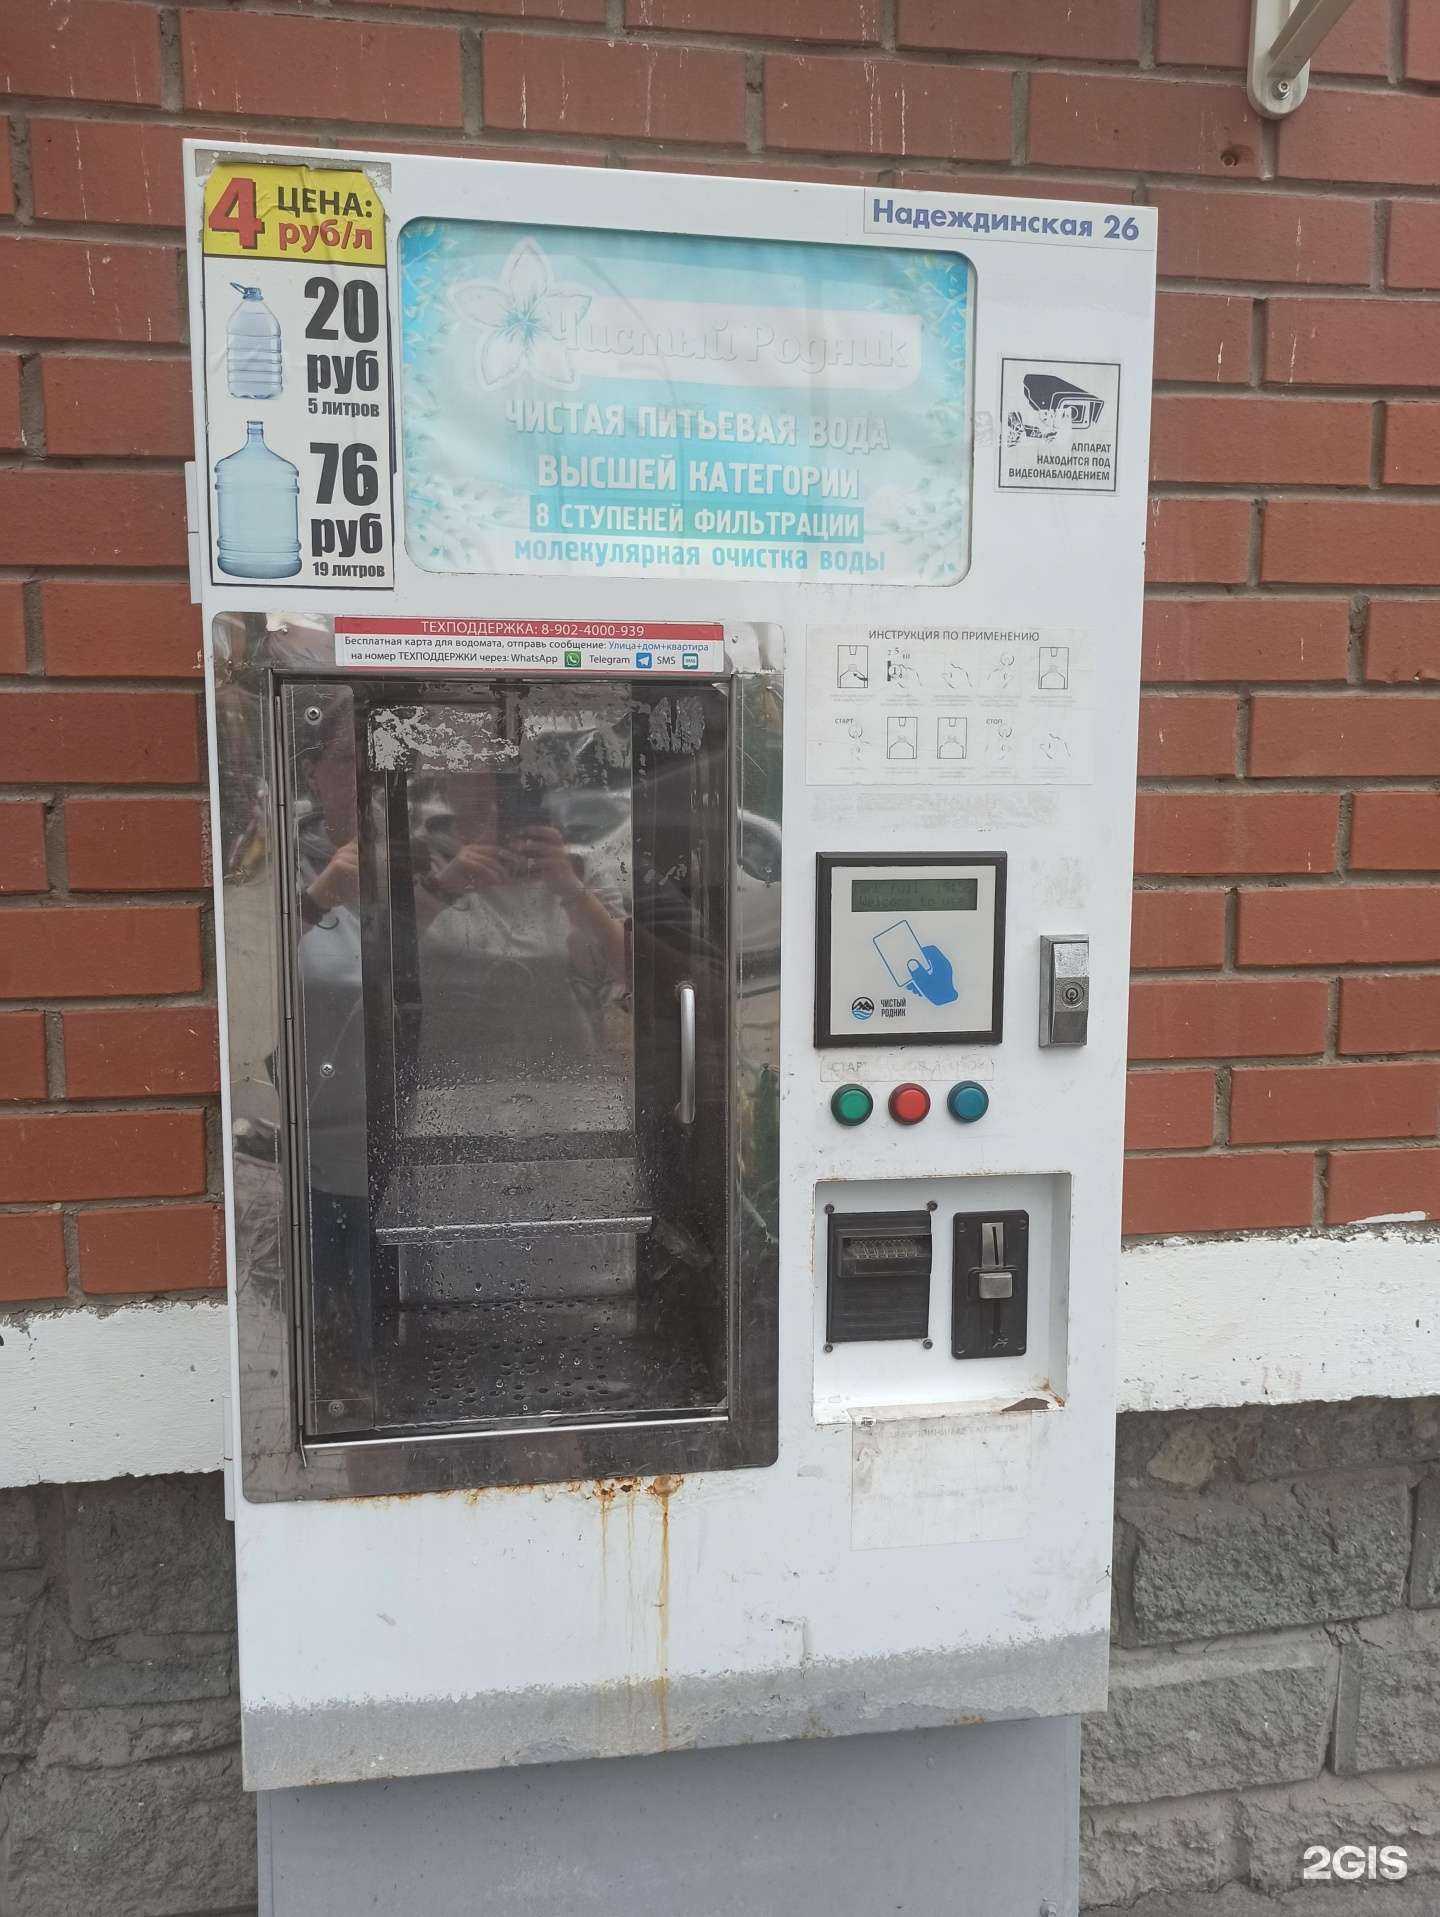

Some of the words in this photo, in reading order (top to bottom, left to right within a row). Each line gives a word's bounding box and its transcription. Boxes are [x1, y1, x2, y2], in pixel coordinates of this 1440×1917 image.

[208, 177, 265, 250] 4
[277, 186, 373, 218] ЦЕНА:
[278, 218, 373, 253] руб/л
[872, 199, 1093, 238] Надеждинская
[1103, 214, 1140, 241] 26
[304, 276, 380, 343] 20
[745, 321, 913, 374] Родник
[306, 350, 379, 394] руб
[308, 398, 318, 414] 5
[321, 401, 380, 418] литров
[505, 397, 625, 437] ЧИСТАЯ
[637, 405, 798, 447] ПИТЬЕВАЯ
[808, 415, 892, 455] ВОДА
[1036, 455, 1090, 467] НАХОДИТСЯ
[1092, 457, 1111, 468] ПОД
[1071, 442, 1112, 453] АППАРАТ
[309, 441, 379, 507] 76
[537, 453, 677, 491] ВЫСШЕЙ
[689, 460, 861, 500] КАТЕГОРИИ
[1008, 467, 1110, 481] ВИДЕОНАБЛЮДЕНИЕМ
[310, 512, 383, 558] руб
[535, 502, 550, 527] 8
[560, 503, 685, 533] СТУПЕНЕЙ
[693, 507, 860, 541] ФИЛЬТРАЦИИ
[312, 561, 329, 577] 19
[332, 564, 386, 579] литров
[514, 539, 701, 569] молекулярная
[712, 546, 808, 570] очистка
[819, 551, 885, 575] воды
[345, 636, 402, 646] Бесплатная
[404, 639, 433, 649] карта
[434, 639, 453, 649] для
[455, 639, 505, 649] водомата,
[507, 640, 547, 650] отправь
[549, 641, 607, 652] сообщение:
[421, 621, 539, 636] ТЕХПОДДЕРЖКА:
[541, 623, 645, 637] 8-902-4000-939
[868, 630, 940, 642] ИНСТРУКЦИЯ
[942, 631, 959, 641] ПО
[961, 631, 1040, 642] ПРИМЕНЕНИЮ
[351, 652, 364, 661] на
[364, 653, 397, 663] номер
[398, 652, 477, 663] ТЕХПОДДЕРЖКИ
[479, 654, 509, 664] через:
[510, 653, 558, 664] WhatsApp
[588, 654, 631, 666] Telegram
[656, 655, 676, 665] SMS
